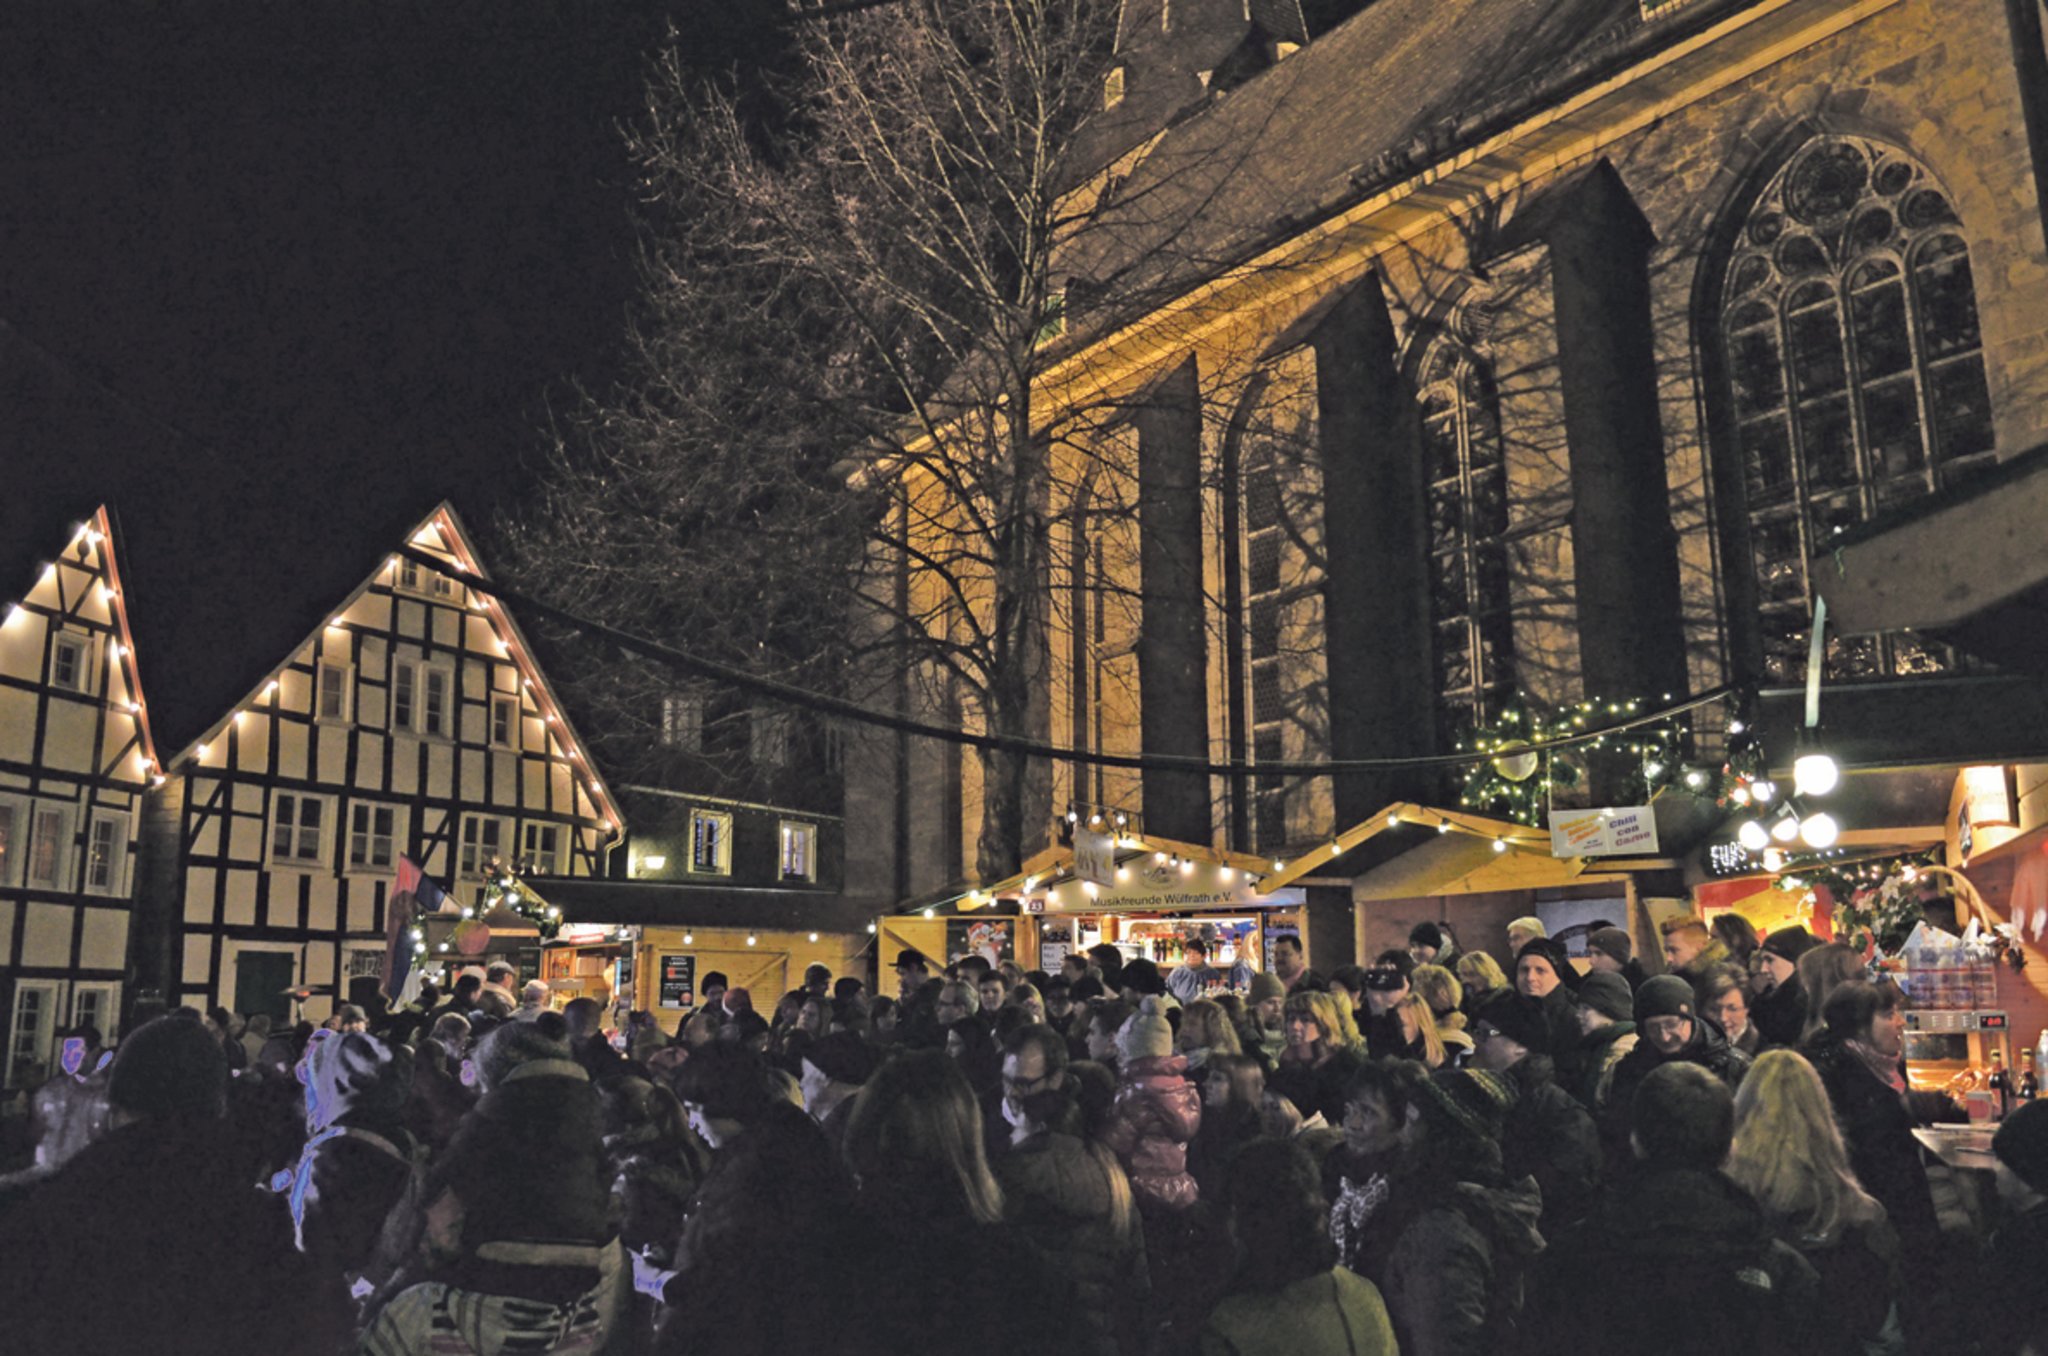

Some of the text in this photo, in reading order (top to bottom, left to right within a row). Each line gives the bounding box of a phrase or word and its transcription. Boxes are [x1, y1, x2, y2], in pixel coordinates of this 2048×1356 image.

[1616, 825, 1640, 837] con
[1090, 891, 1233, 907] Musikfreunde Wülfrath e.V.
